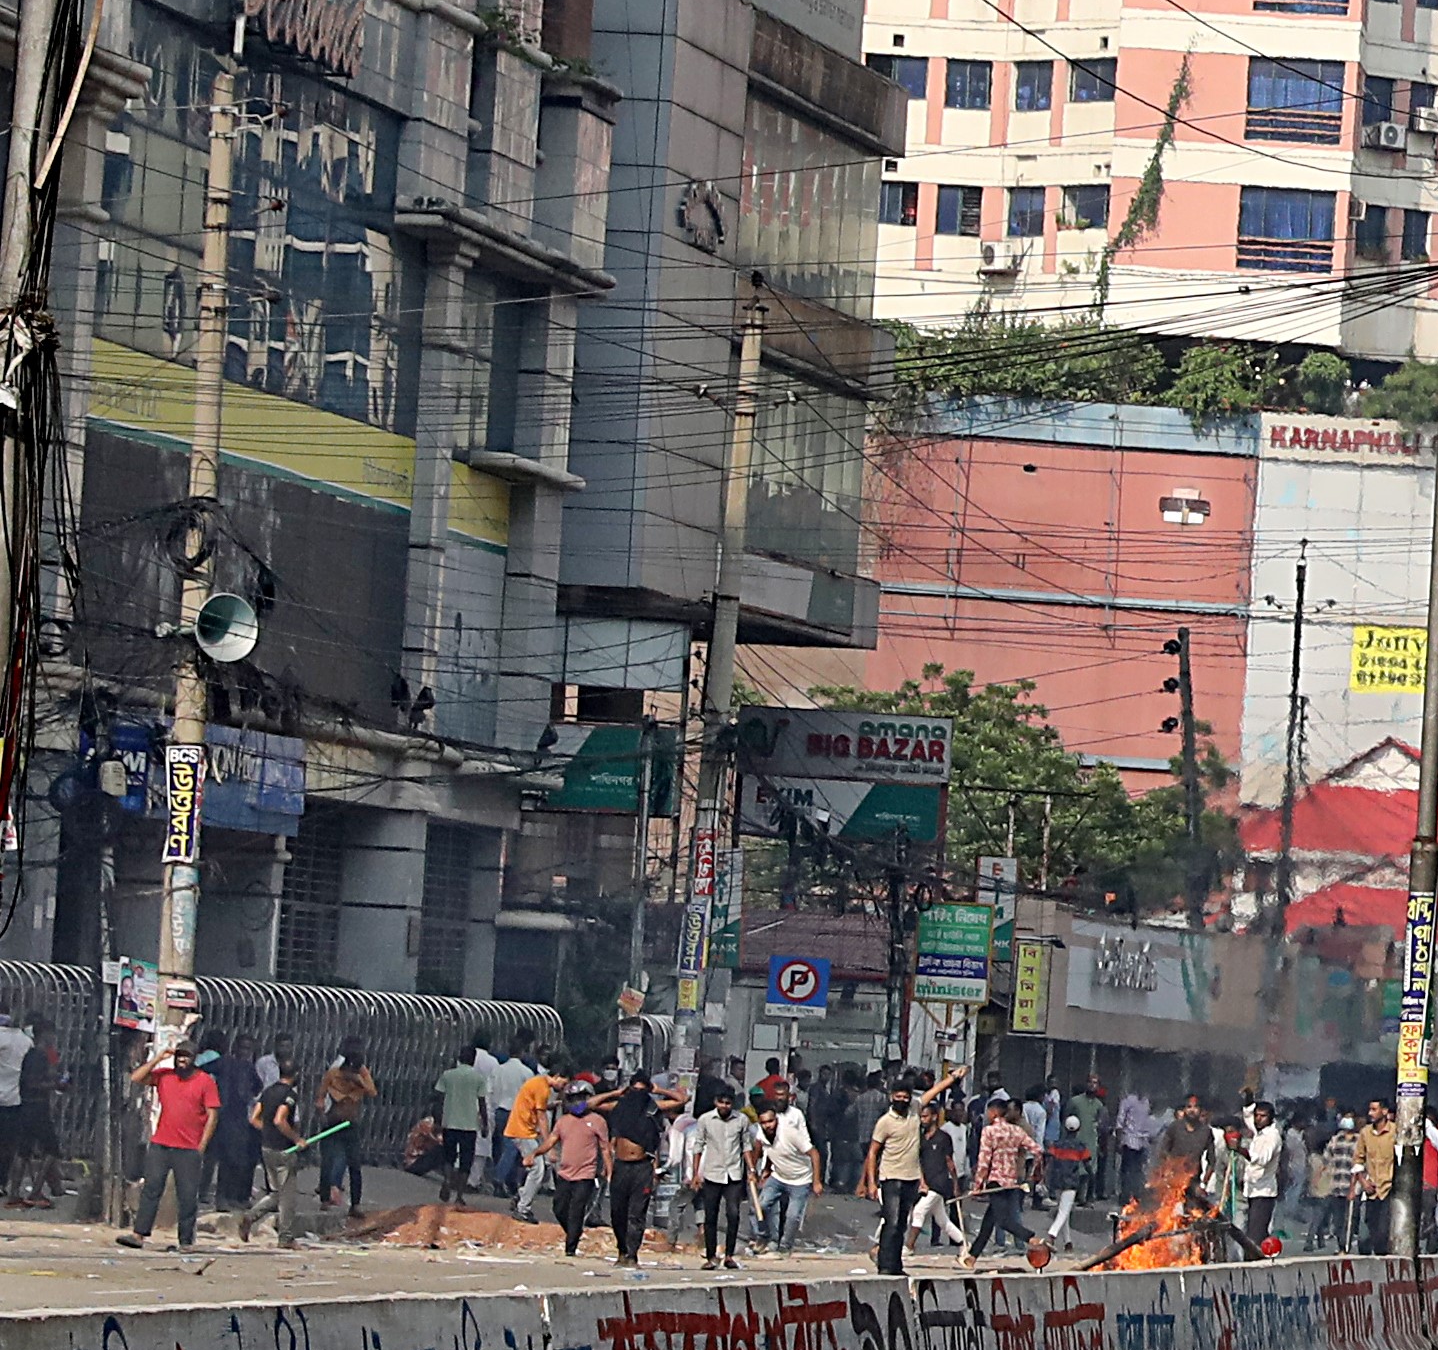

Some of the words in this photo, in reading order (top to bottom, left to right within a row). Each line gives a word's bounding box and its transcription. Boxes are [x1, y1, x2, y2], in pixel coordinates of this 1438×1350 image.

[1270, 424, 1420, 456] KARNAPHULI
[859, 720, 946, 740] amana
[168, 749, 199, 763] BCS
[807, 733, 850, 758] BIG
[857, 736, 946, 763] BAZAR
[916, 981, 983, 998] minister
